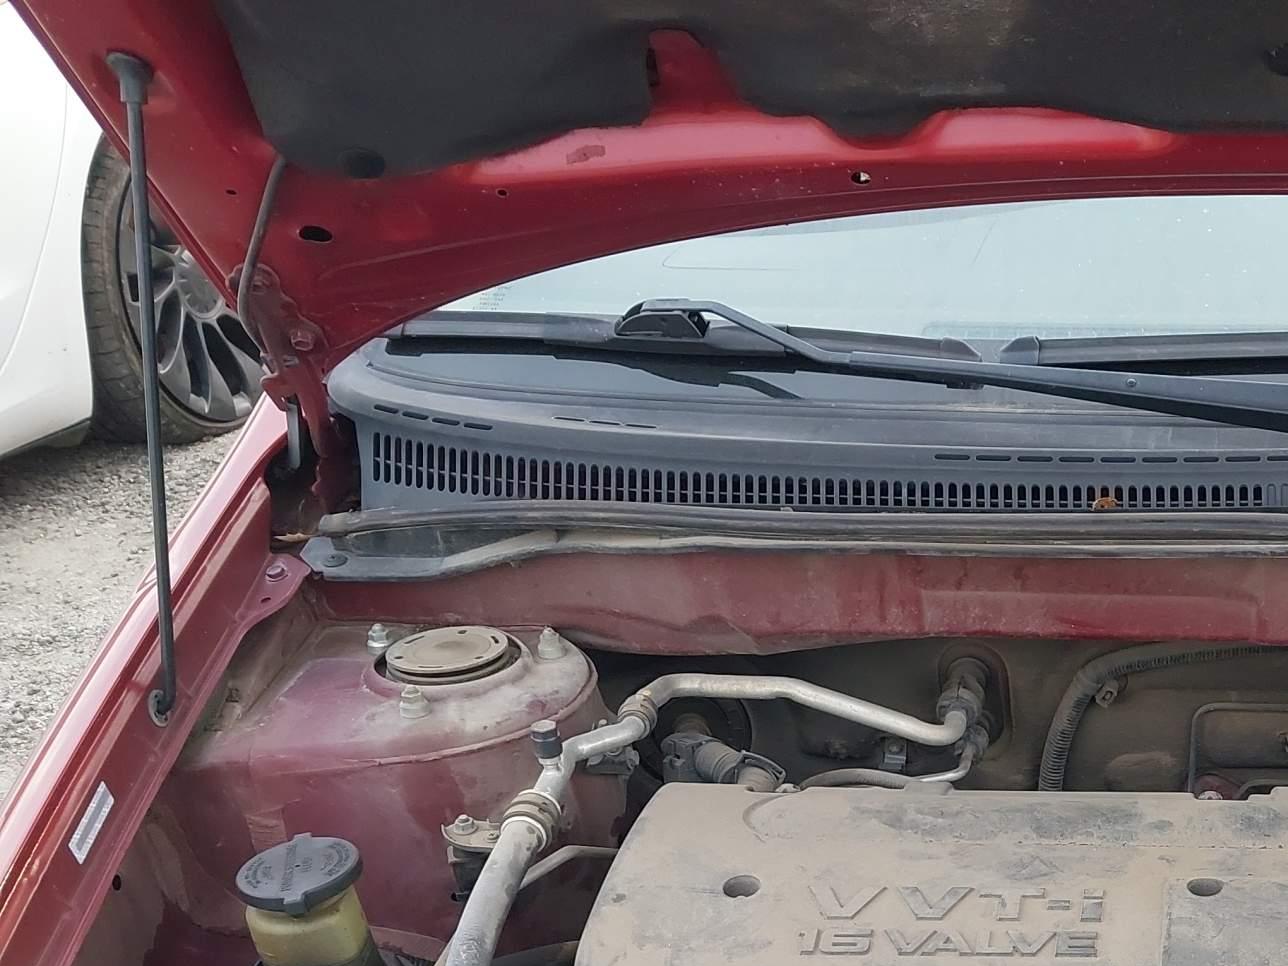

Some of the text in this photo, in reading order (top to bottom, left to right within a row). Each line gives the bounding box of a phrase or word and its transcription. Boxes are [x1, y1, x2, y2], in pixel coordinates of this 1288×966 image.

[808, 886, 1104, 922] VVT-i
[799, 928, 1098, 957] 16 VALVE
